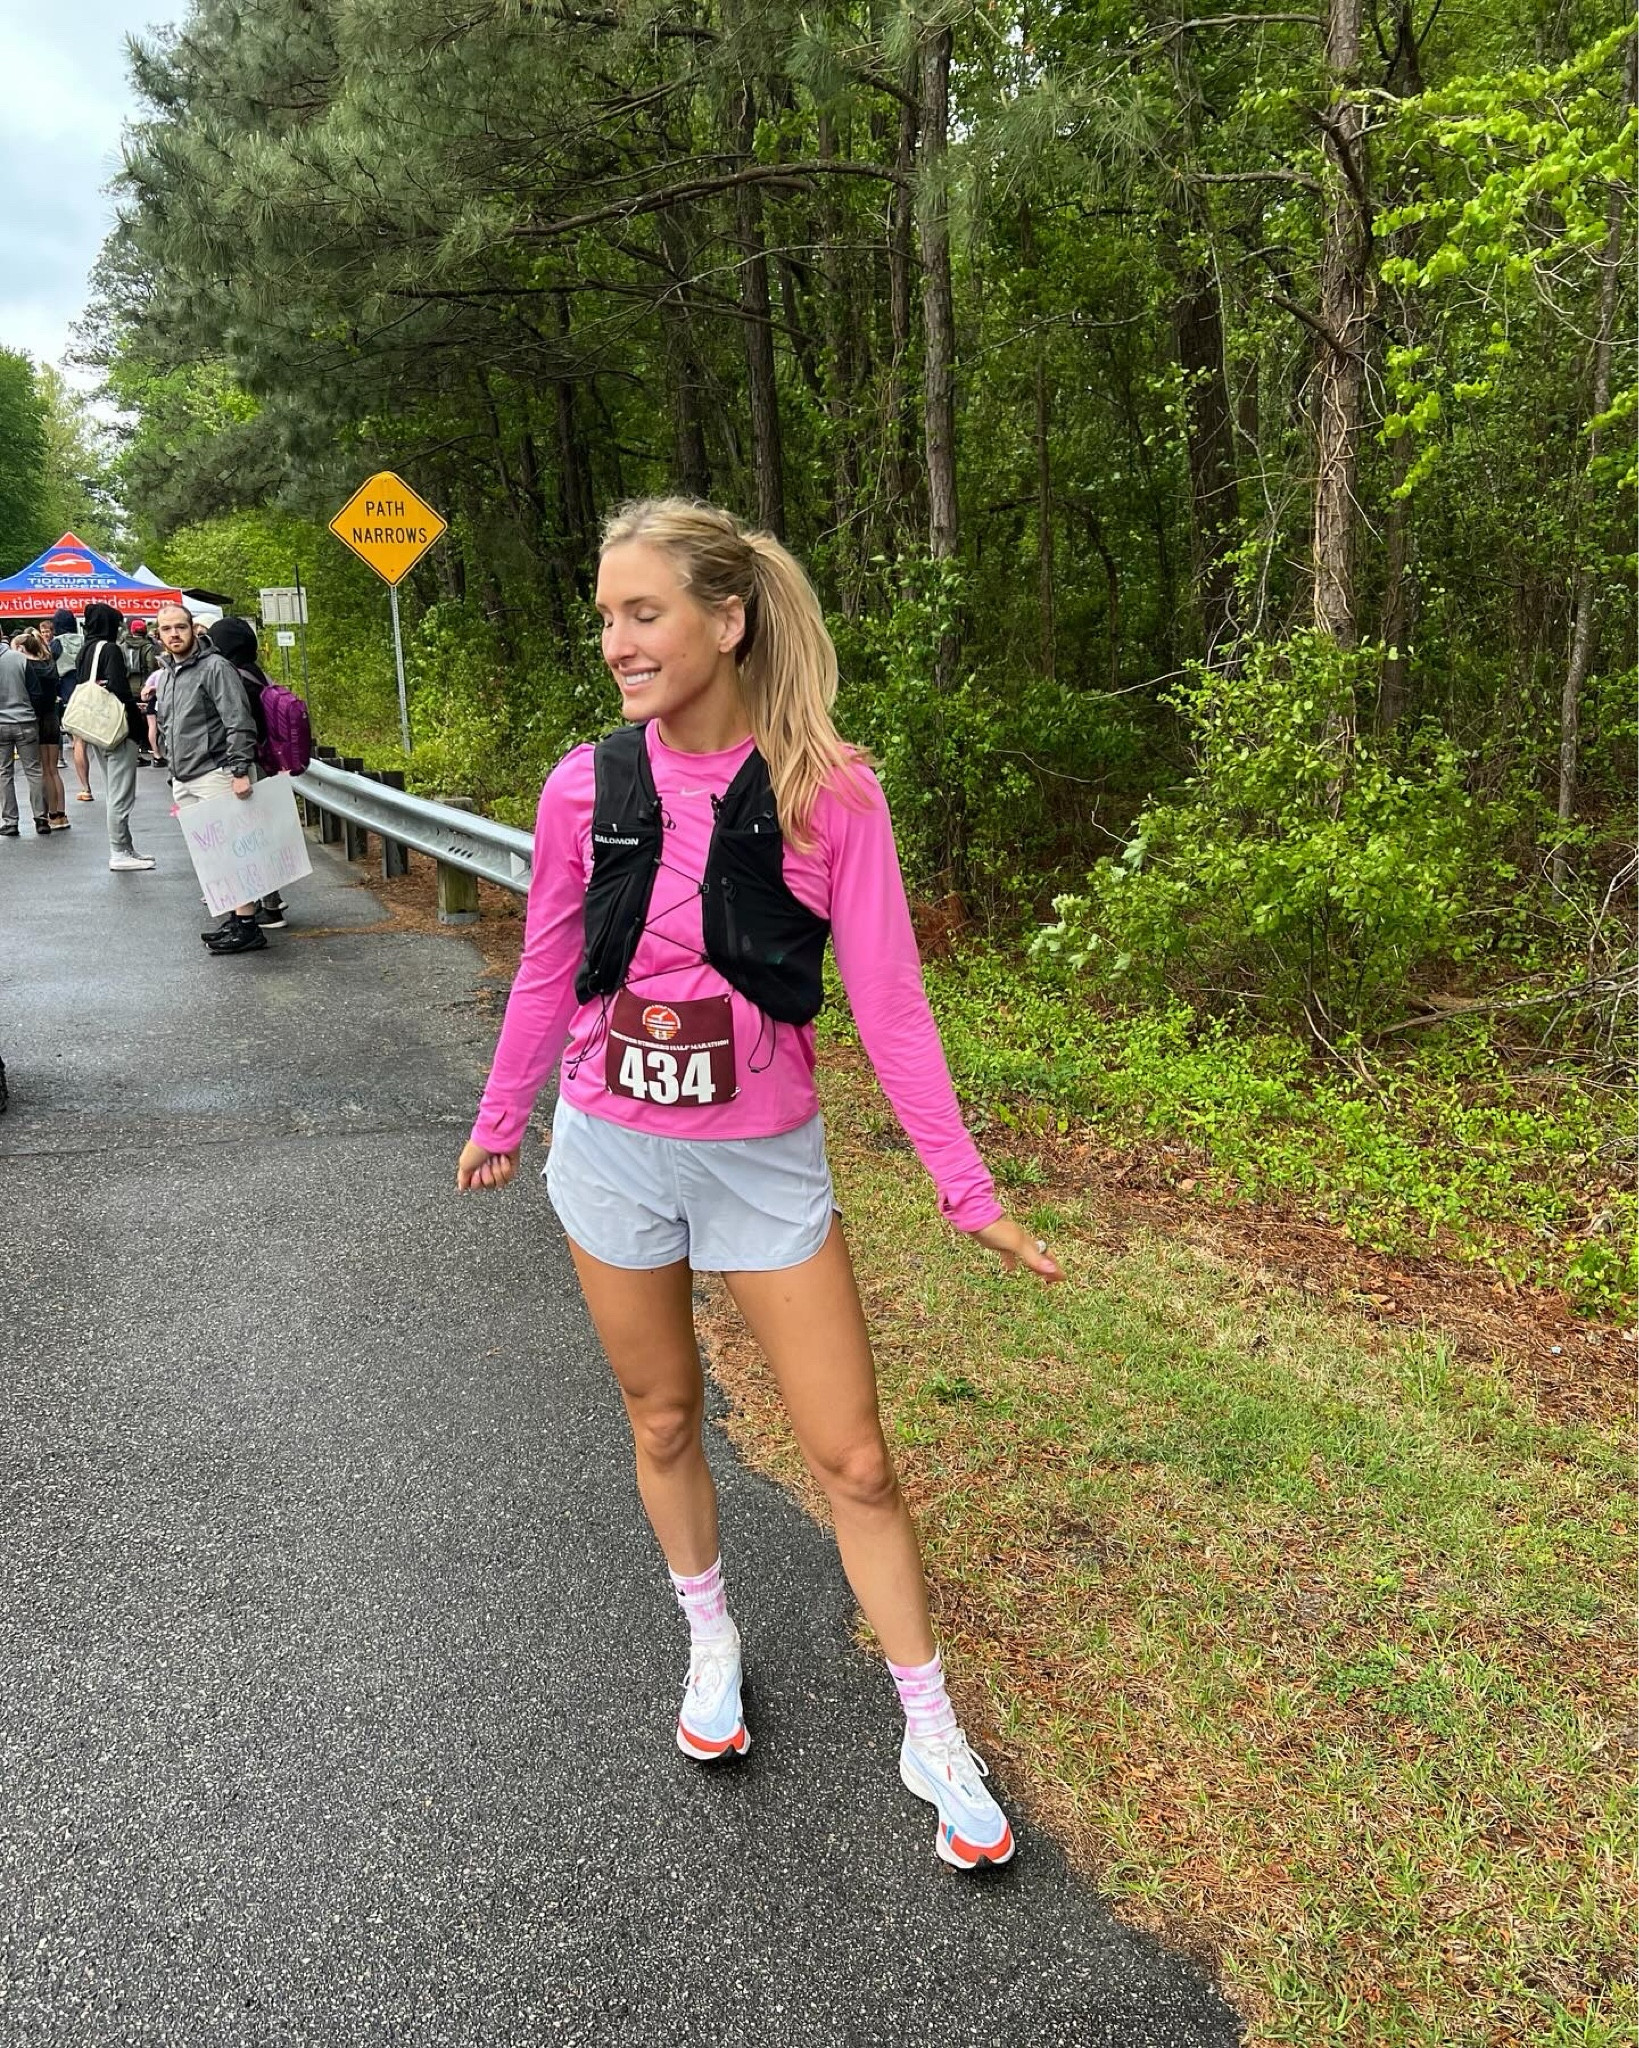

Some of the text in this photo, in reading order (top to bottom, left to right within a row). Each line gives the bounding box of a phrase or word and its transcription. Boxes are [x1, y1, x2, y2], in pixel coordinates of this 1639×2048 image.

[365, 500, 405, 517] PATH
[352, 527, 428, 544] NARROWS
[594, 833, 639, 846] SALOMON
[619, 1045, 716, 1105] 434
